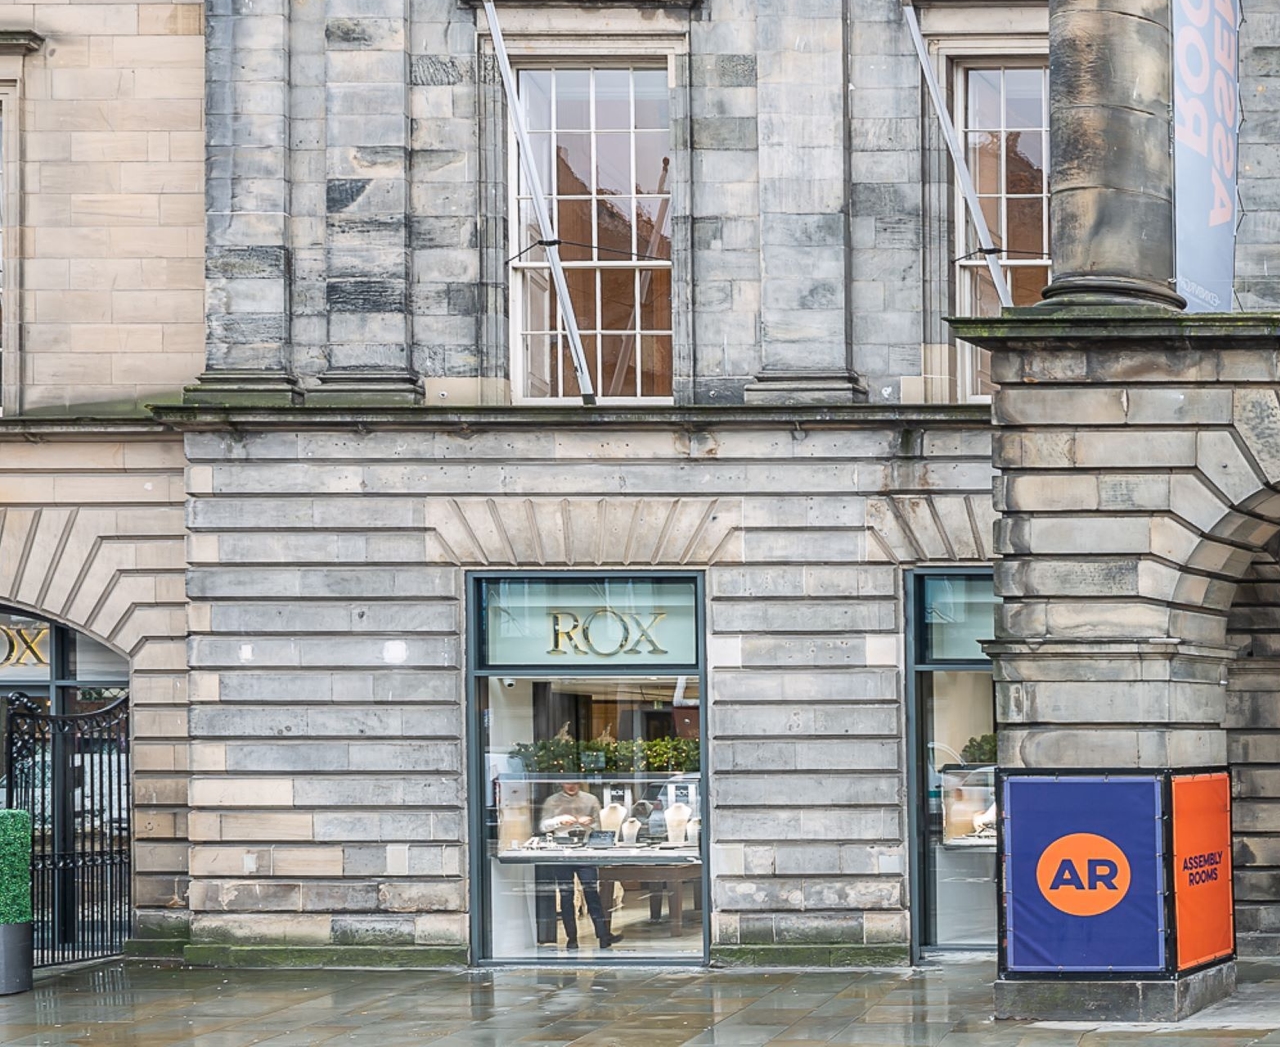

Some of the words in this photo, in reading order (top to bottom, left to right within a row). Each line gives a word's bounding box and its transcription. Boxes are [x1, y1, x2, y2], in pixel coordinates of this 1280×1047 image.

[546, 608, 668, 657] ROX
[1048, 859, 1119, 890] AR
[1183, 851, 1224, 872] ASSEMBLY
[1188, 868, 1218, 886] ROOMS
